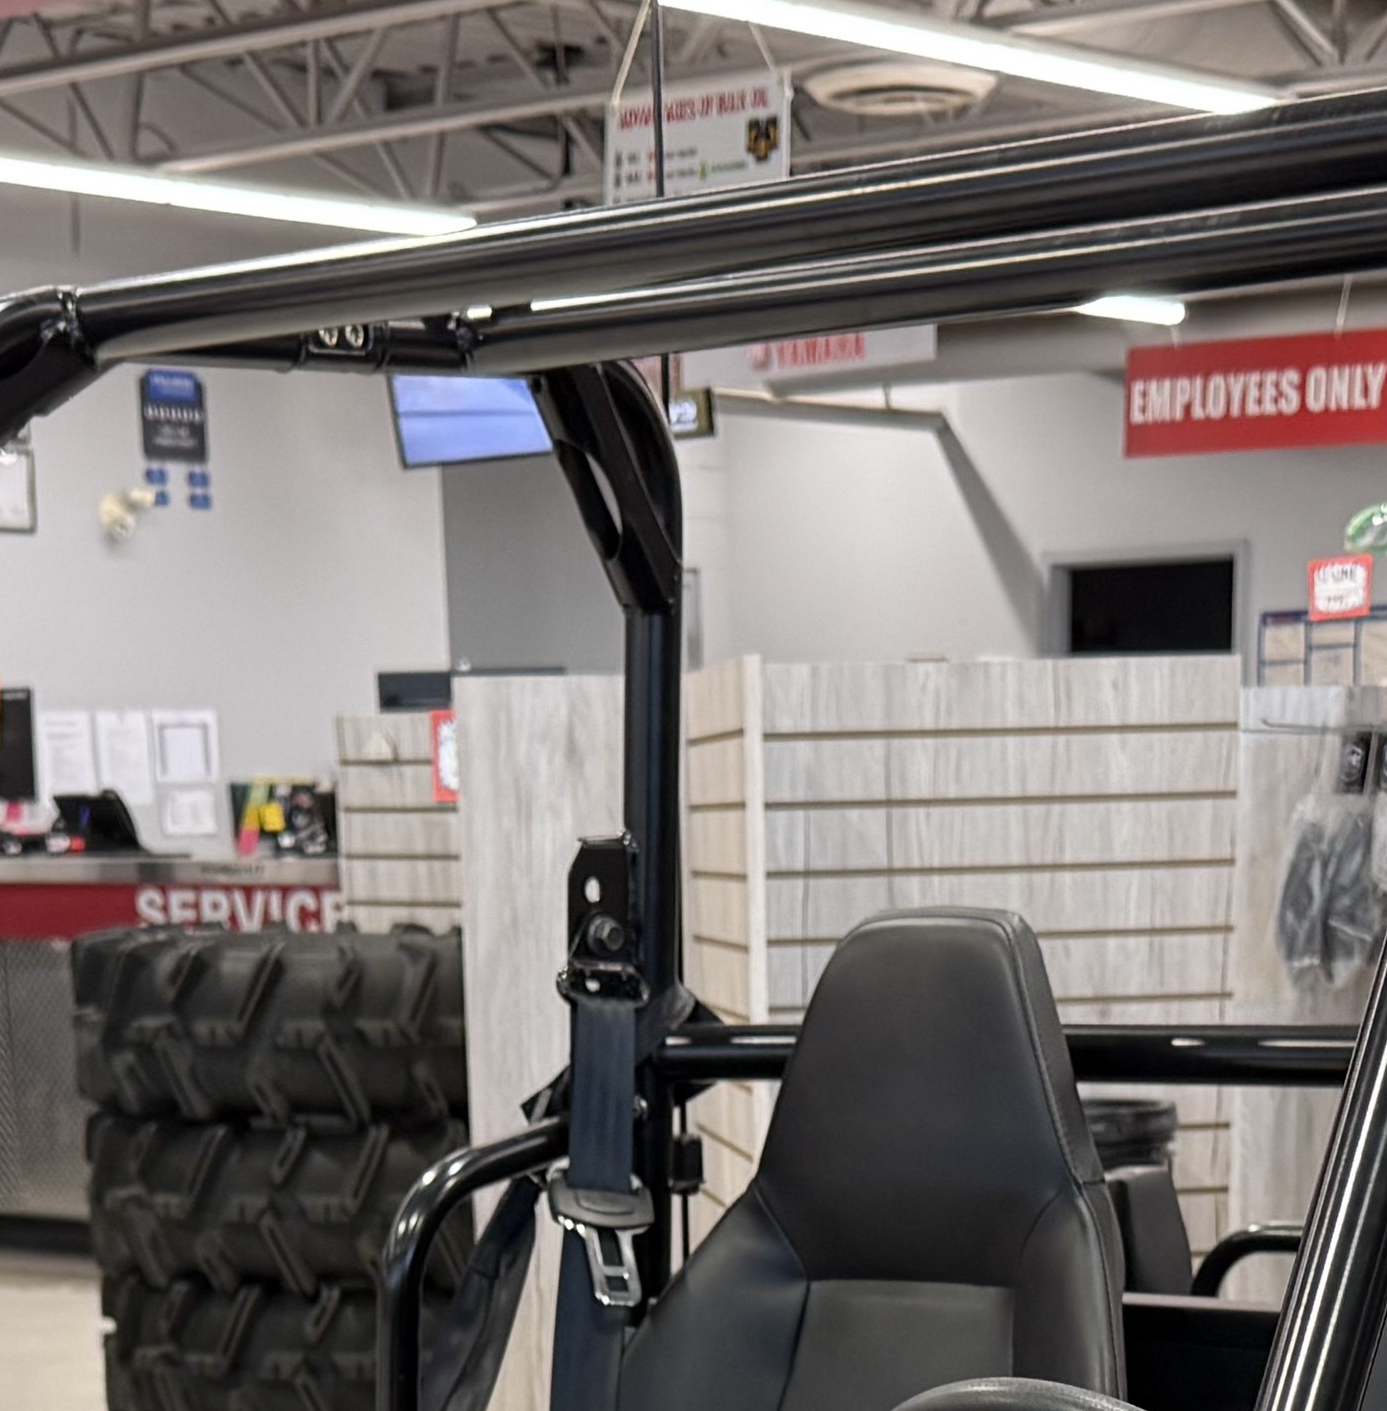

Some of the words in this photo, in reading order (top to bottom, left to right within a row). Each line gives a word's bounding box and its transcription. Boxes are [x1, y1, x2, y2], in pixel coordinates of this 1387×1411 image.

[1129, 366, 1302, 424] EMPLOYEES
[1305, 361, 1387, 413] ONLY
[135, 886, 346, 934] SERVICE
